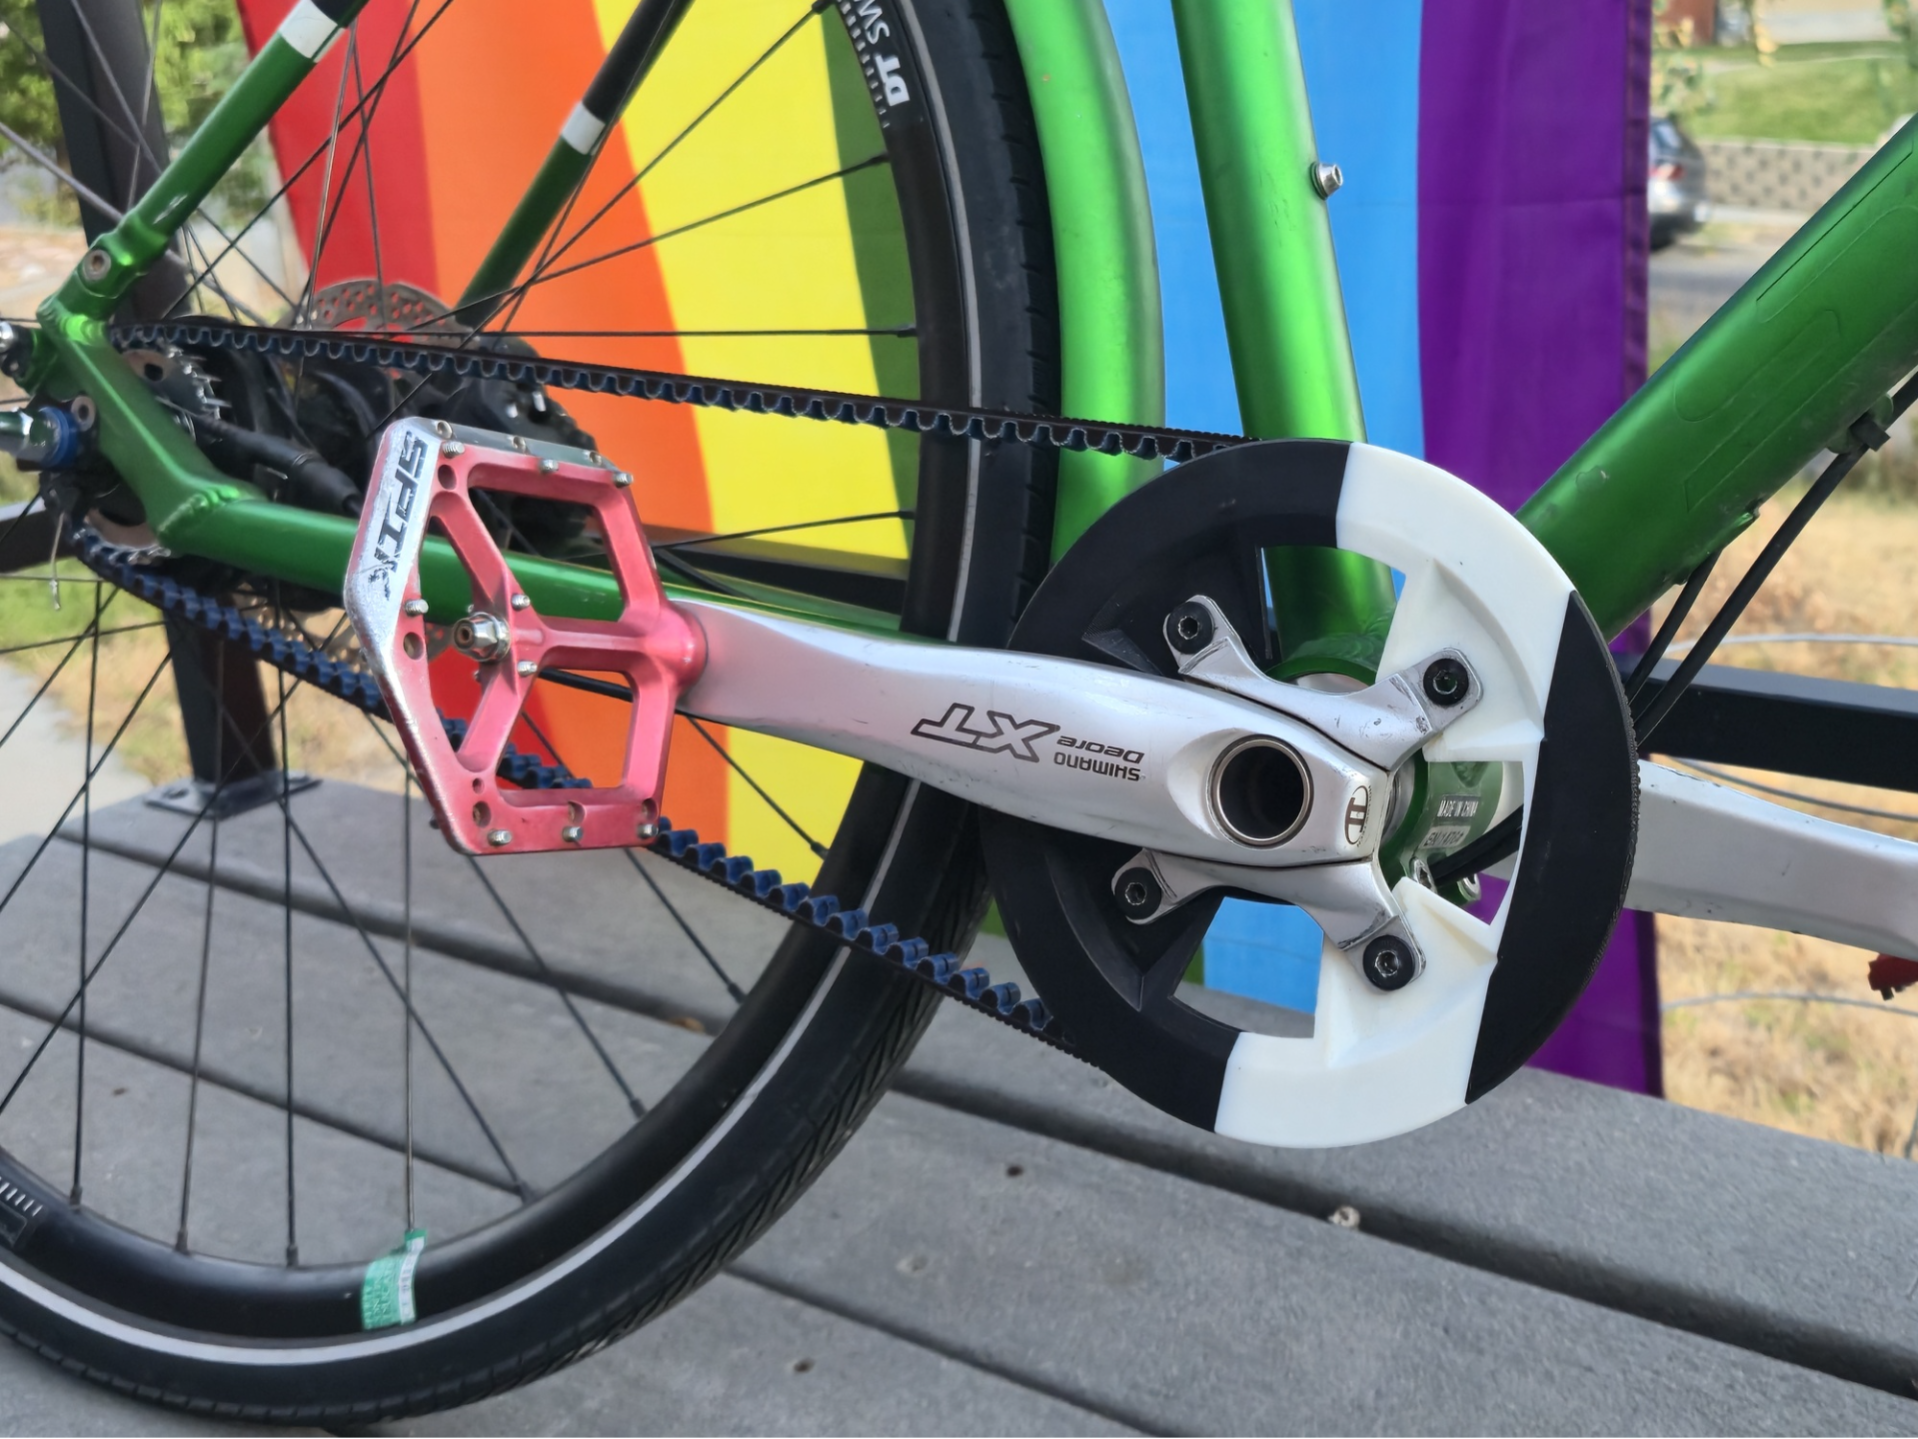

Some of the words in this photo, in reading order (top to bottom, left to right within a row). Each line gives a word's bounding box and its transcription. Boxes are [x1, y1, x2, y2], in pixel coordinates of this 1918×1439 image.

[874, 53, 910, 107] DT
[910, 702, 1061, 763] XT
[1053, 751, 1142, 782] SHIMANO
[1437, 799, 1456, 817] MADE
[1461, 800, 1479, 817] CHINA
